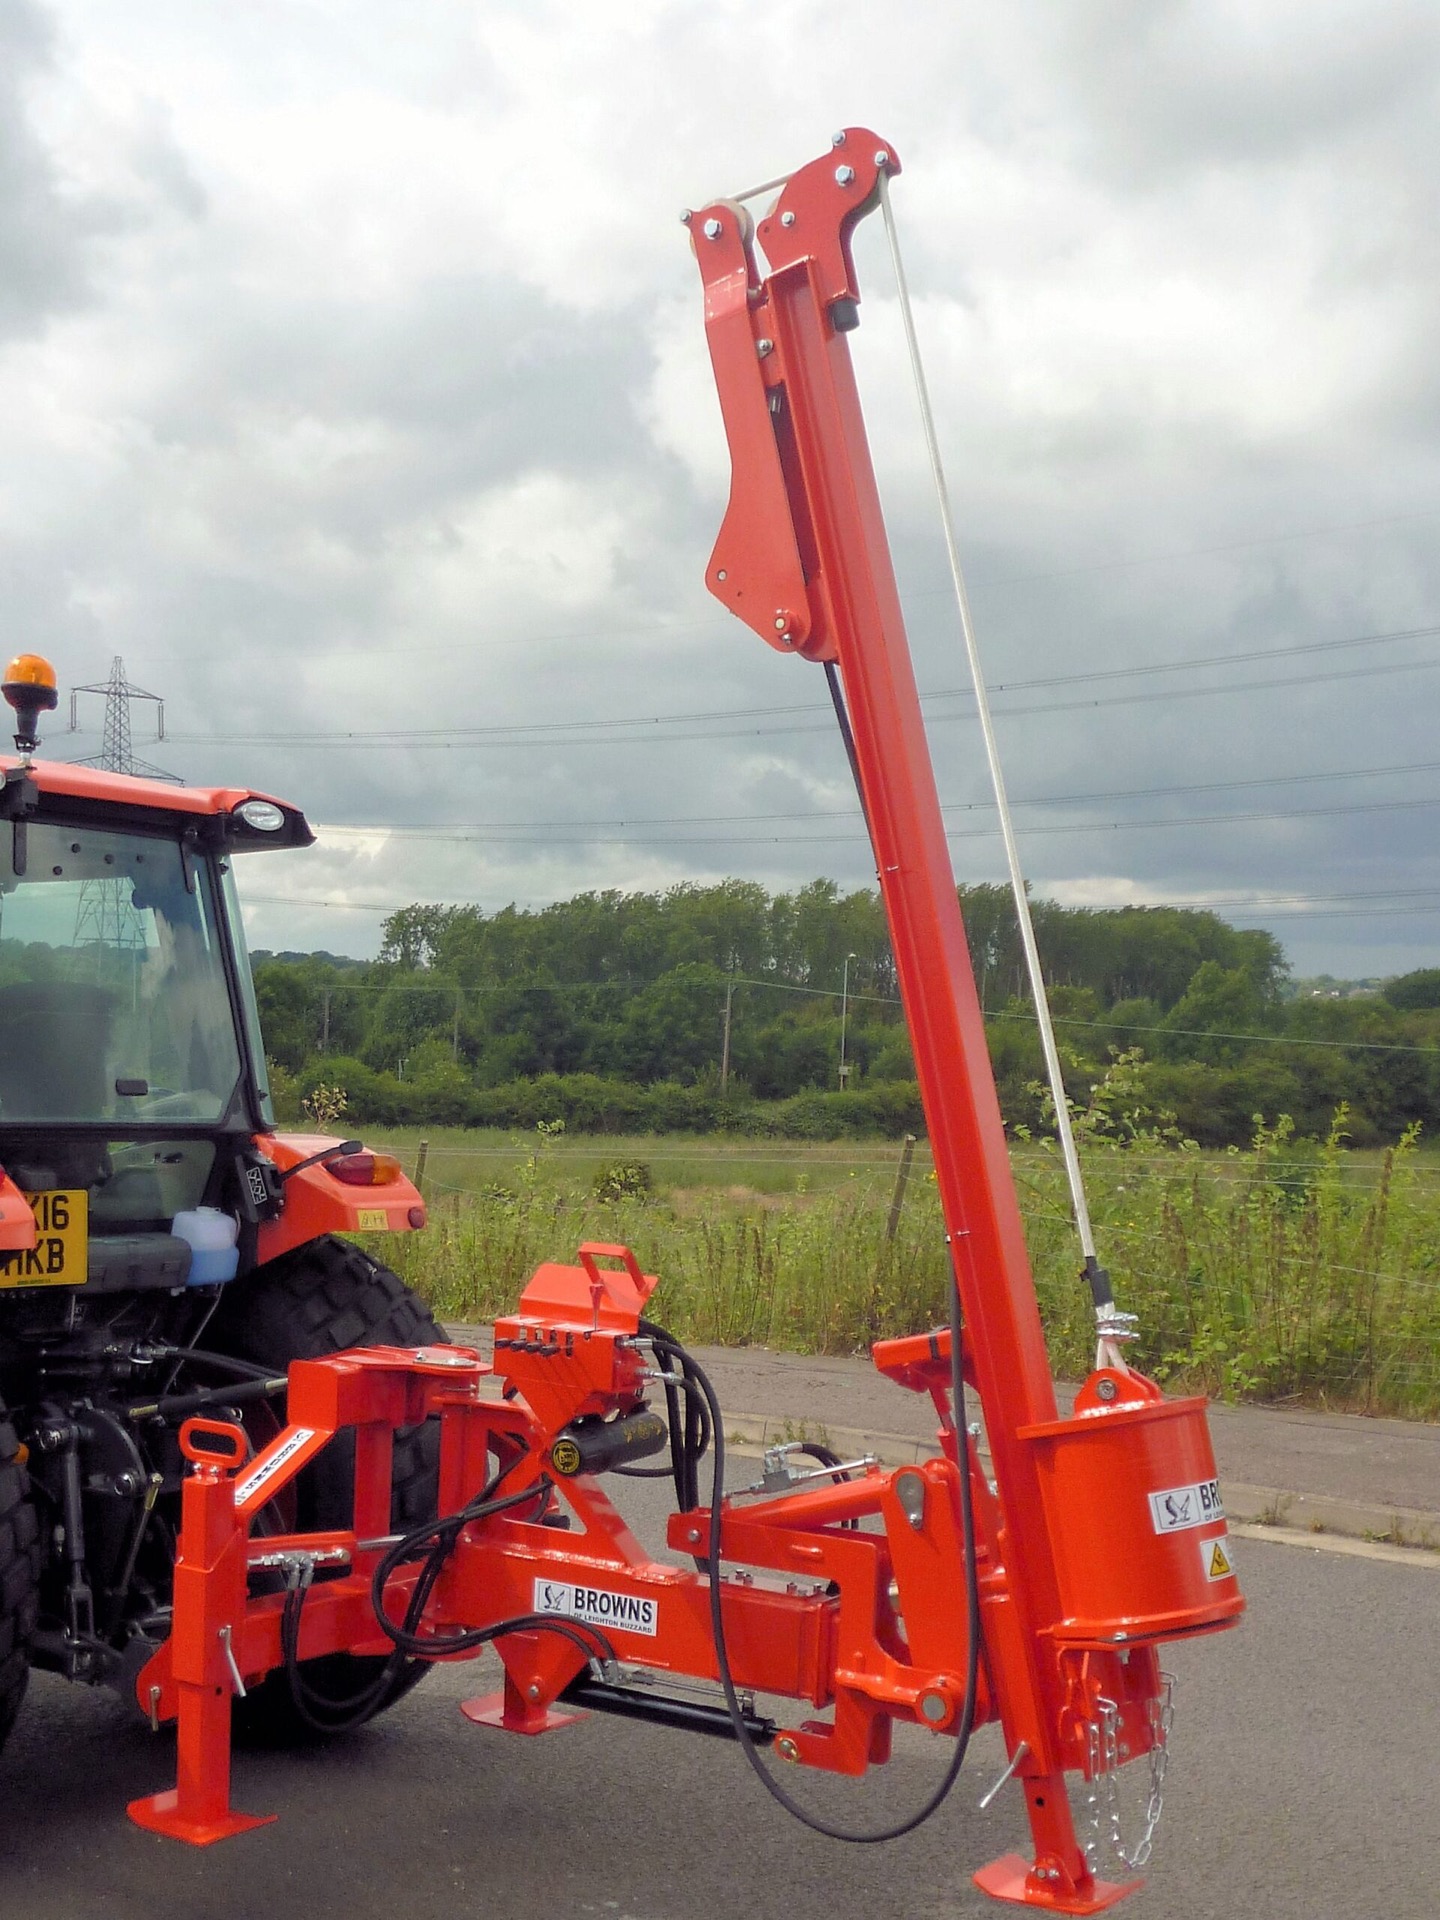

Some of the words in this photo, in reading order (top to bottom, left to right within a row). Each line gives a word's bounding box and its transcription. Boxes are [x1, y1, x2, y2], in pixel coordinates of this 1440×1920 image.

[574, 1587, 653, 1624] BROWNS
[584, 1614, 618, 1626] LEIGHTON
[620, 1622, 652, 1634] BUZZARD
